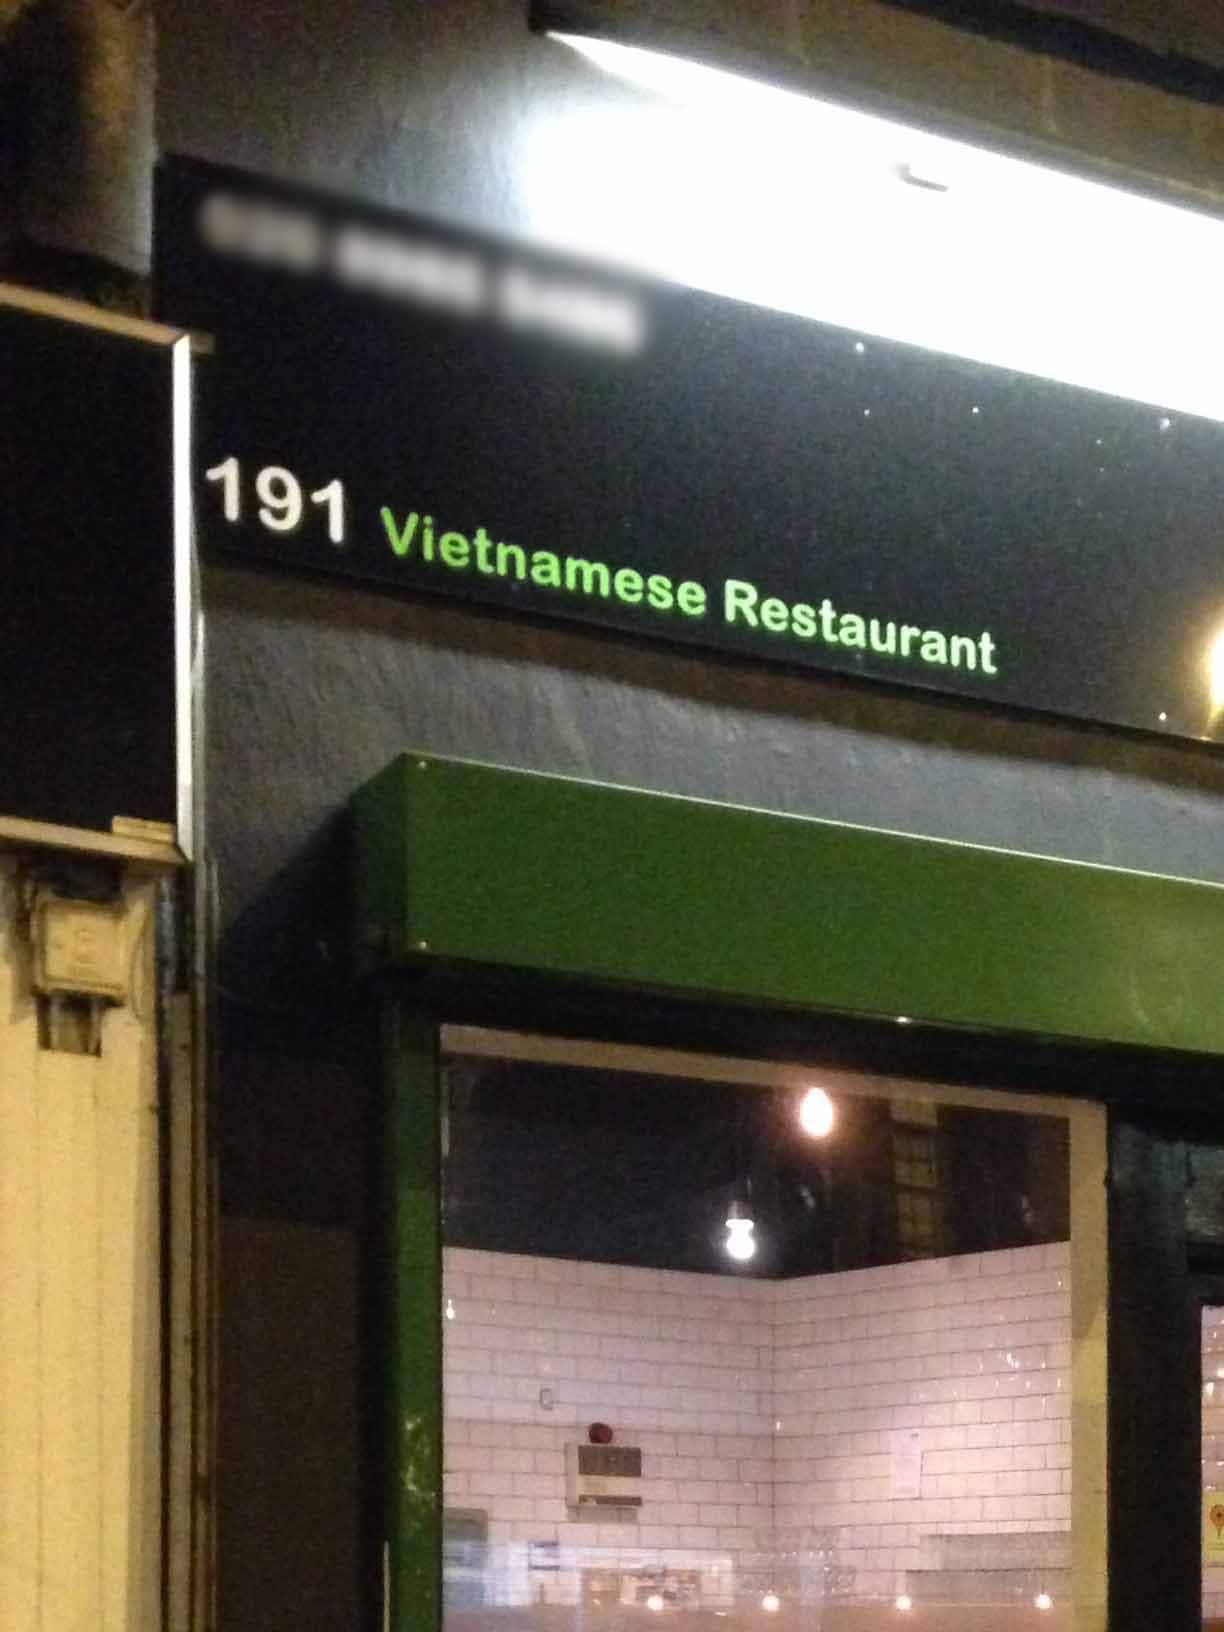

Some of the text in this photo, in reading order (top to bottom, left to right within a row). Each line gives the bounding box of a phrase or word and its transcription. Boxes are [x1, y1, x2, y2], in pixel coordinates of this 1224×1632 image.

[205, 456, 1000, 675] 191 Vietnamese Restaurant
